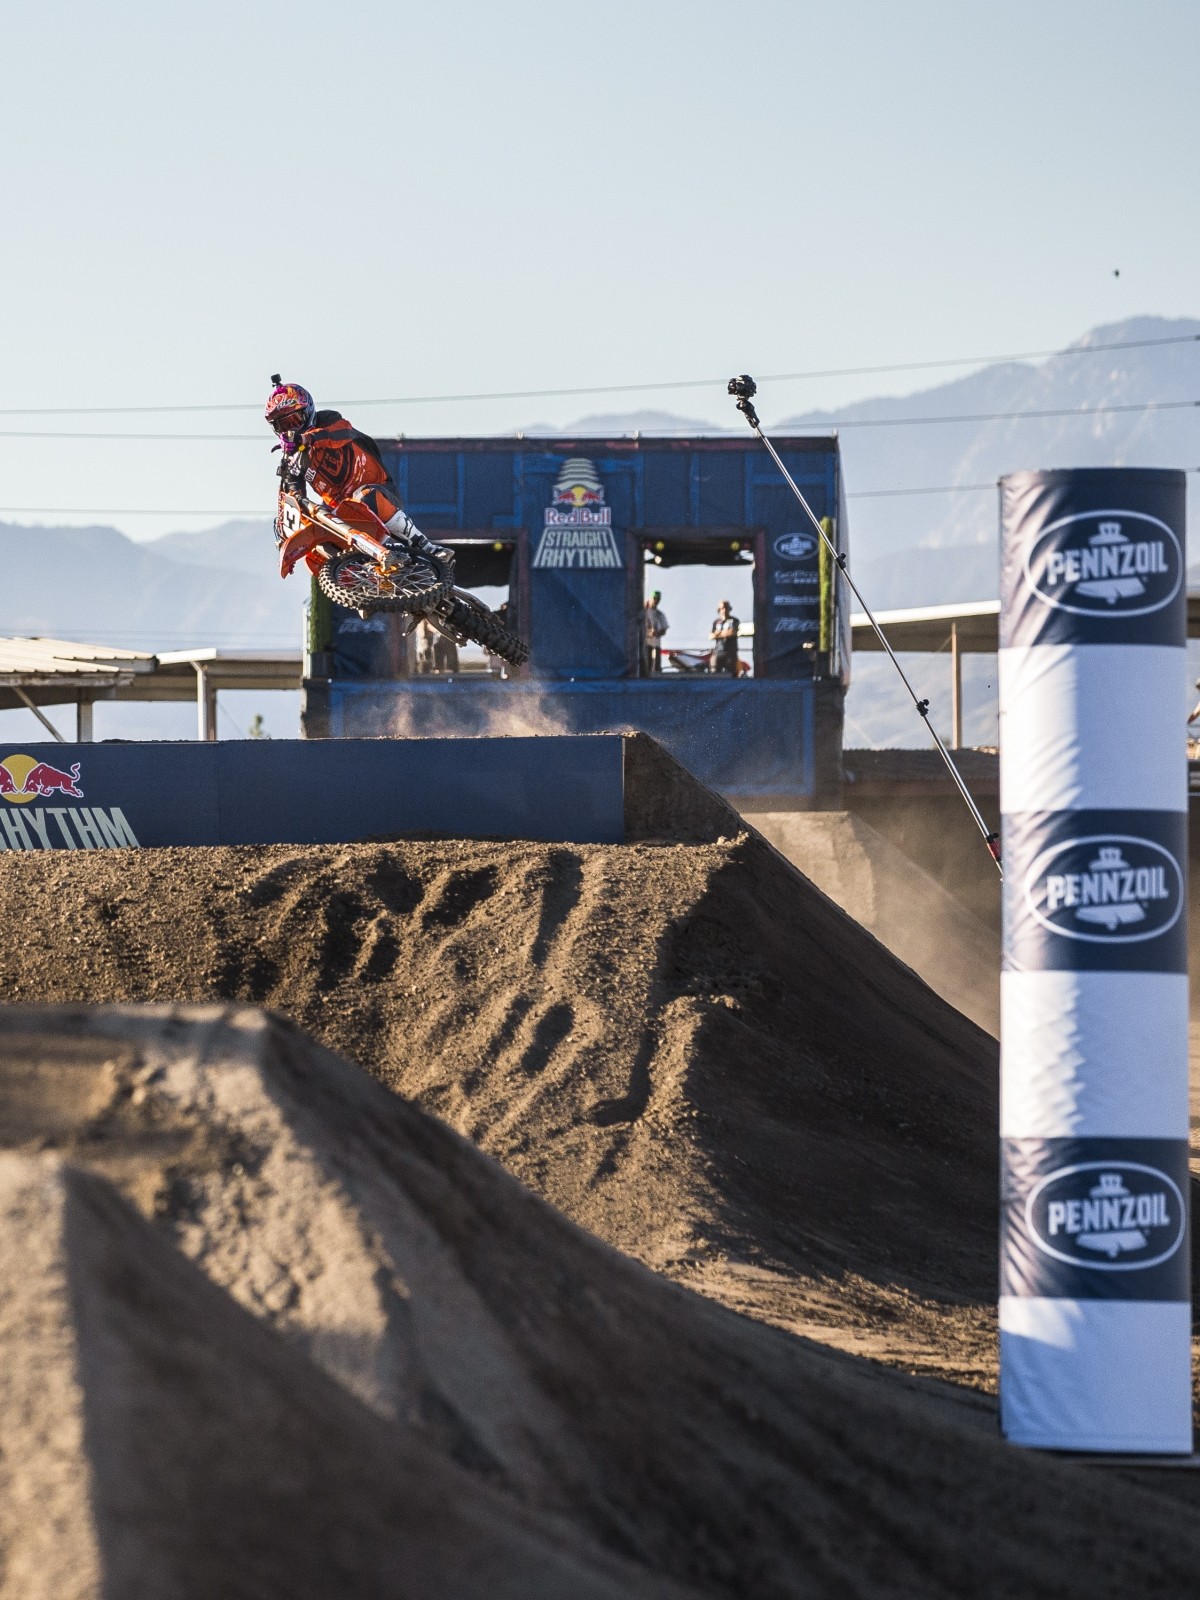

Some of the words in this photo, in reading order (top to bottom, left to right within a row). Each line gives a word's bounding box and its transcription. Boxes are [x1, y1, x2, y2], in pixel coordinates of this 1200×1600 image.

[545, 507, 578, 525] Red
[580, 507, 611, 525] Bull
[545, 531, 609, 546] STRAIGHT
[540, 548, 615, 568] RHYTHM
[1046, 541, 1168, 586] PENNZOIL
[1046, 866, 1170, 910] PENNZOIL
[1048, 1193, 1170, 1236] PENNZOIL
